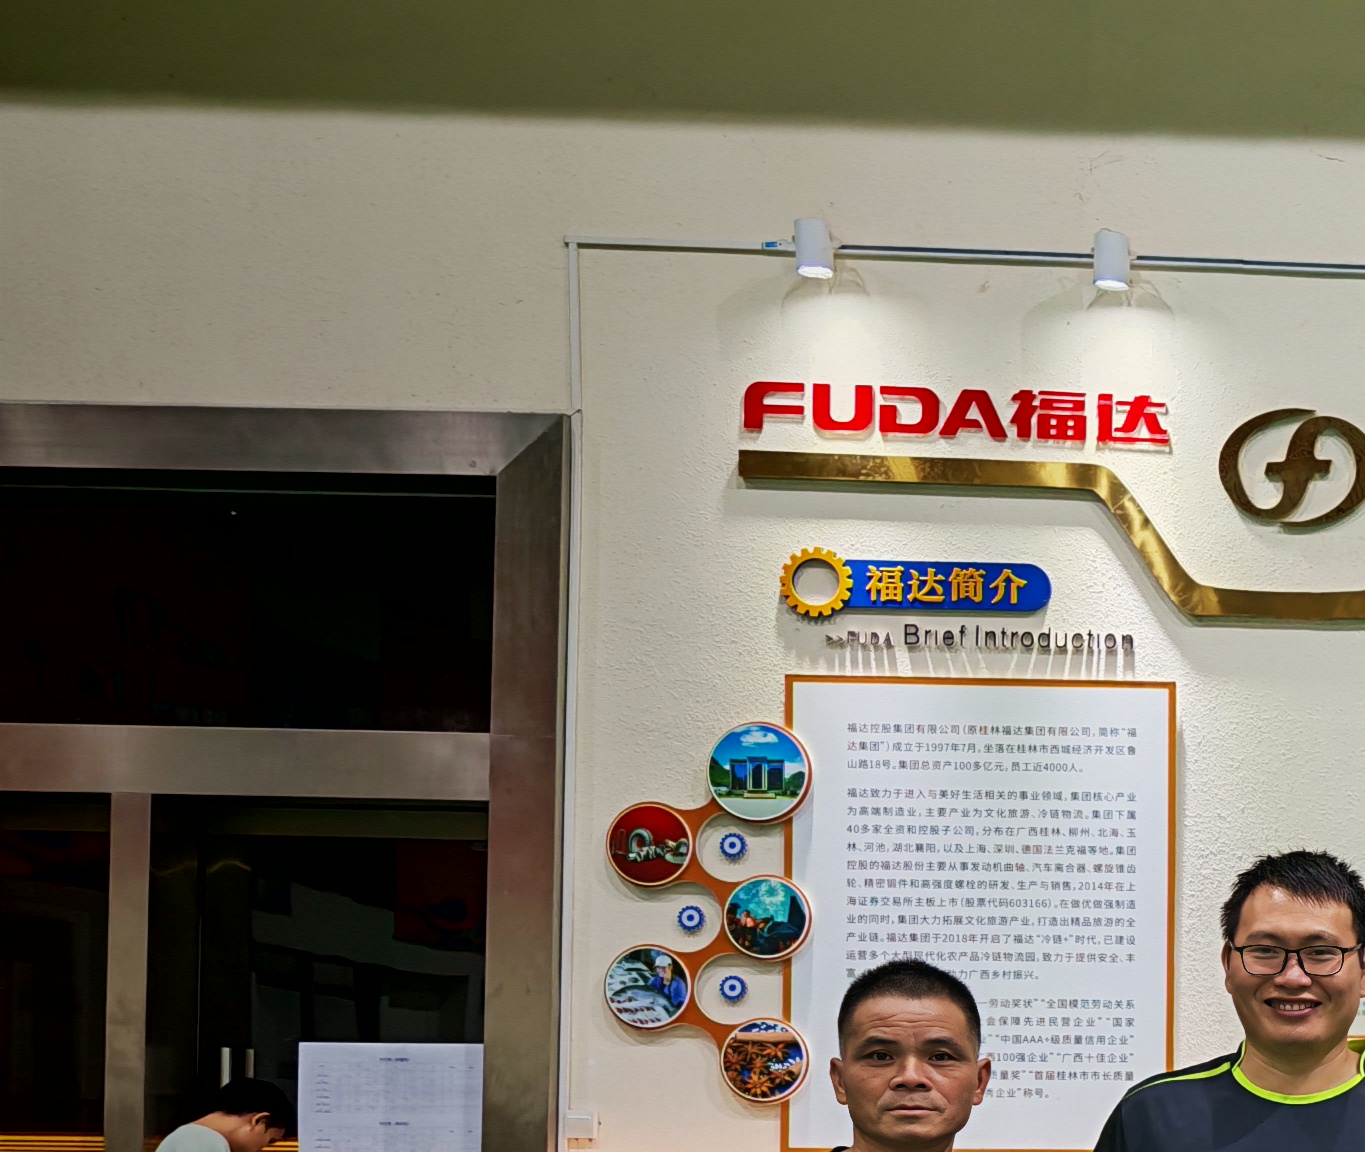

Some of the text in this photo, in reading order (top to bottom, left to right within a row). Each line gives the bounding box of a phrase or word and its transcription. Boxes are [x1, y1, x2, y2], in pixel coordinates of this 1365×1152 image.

[864, 563, 1029, 606] 福达简介
[846, 622, 1136, 653] FUDA Brief Introduction
